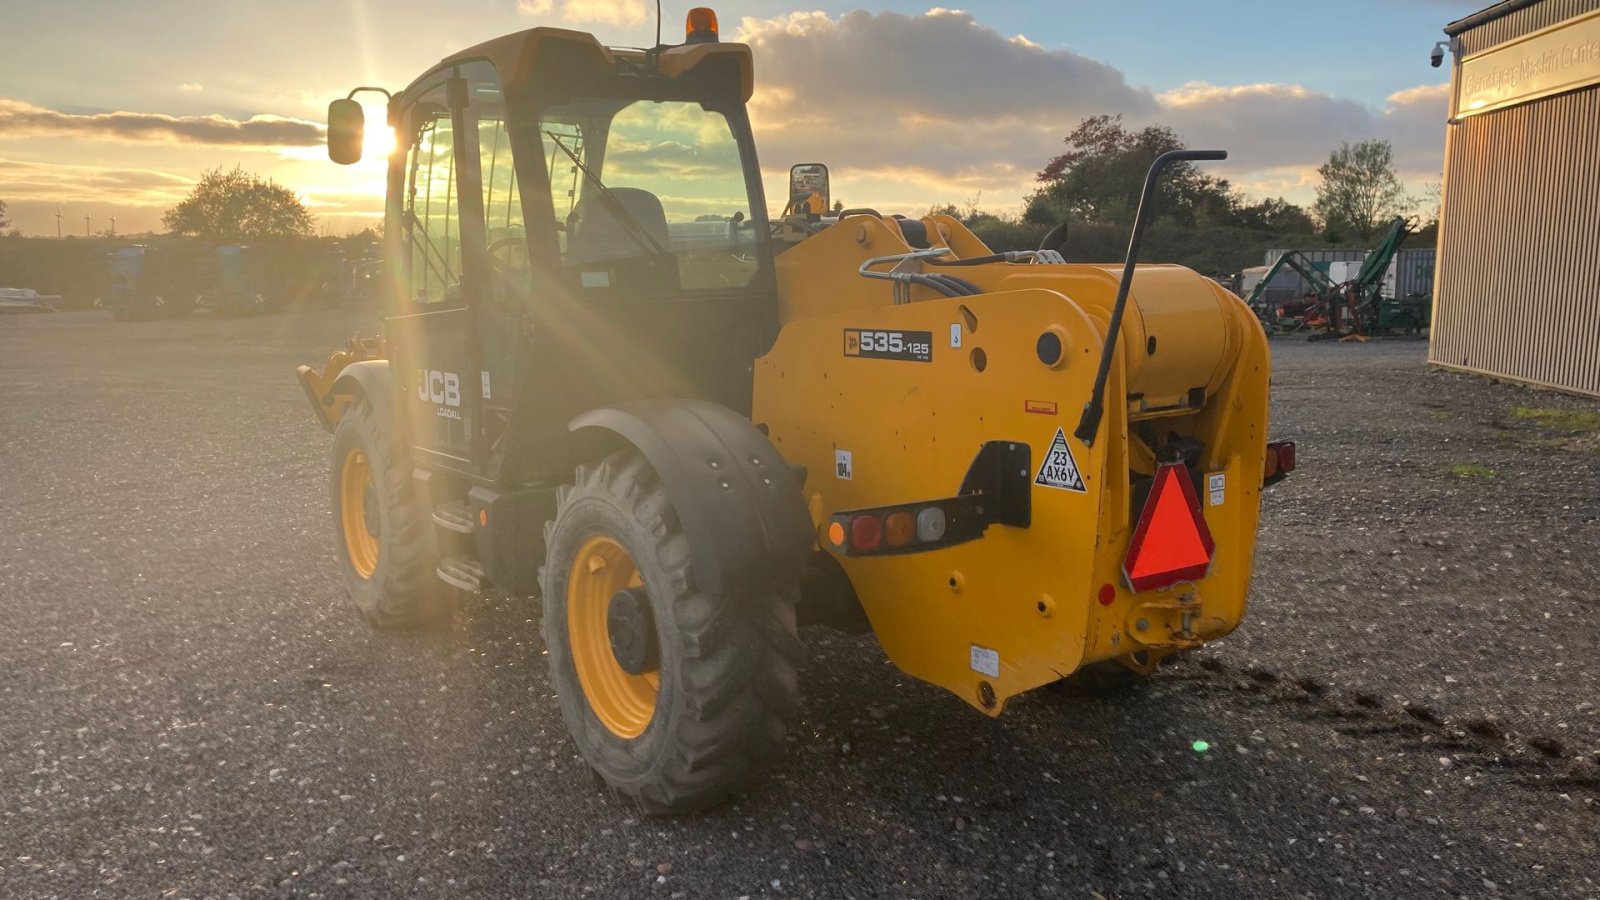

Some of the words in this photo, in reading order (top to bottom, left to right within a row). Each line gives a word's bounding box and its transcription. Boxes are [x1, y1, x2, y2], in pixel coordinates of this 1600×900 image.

[1520, 51, 1560, 80] Maskin
[1562, 39, 1600, 68] Cente
[417, 369, 461, 407] JCB
[437, 408, 461, 420] LOADALL
[1053, 451, 1067, 466] 23
[1046, 465, 1074, 482] AX6Y
